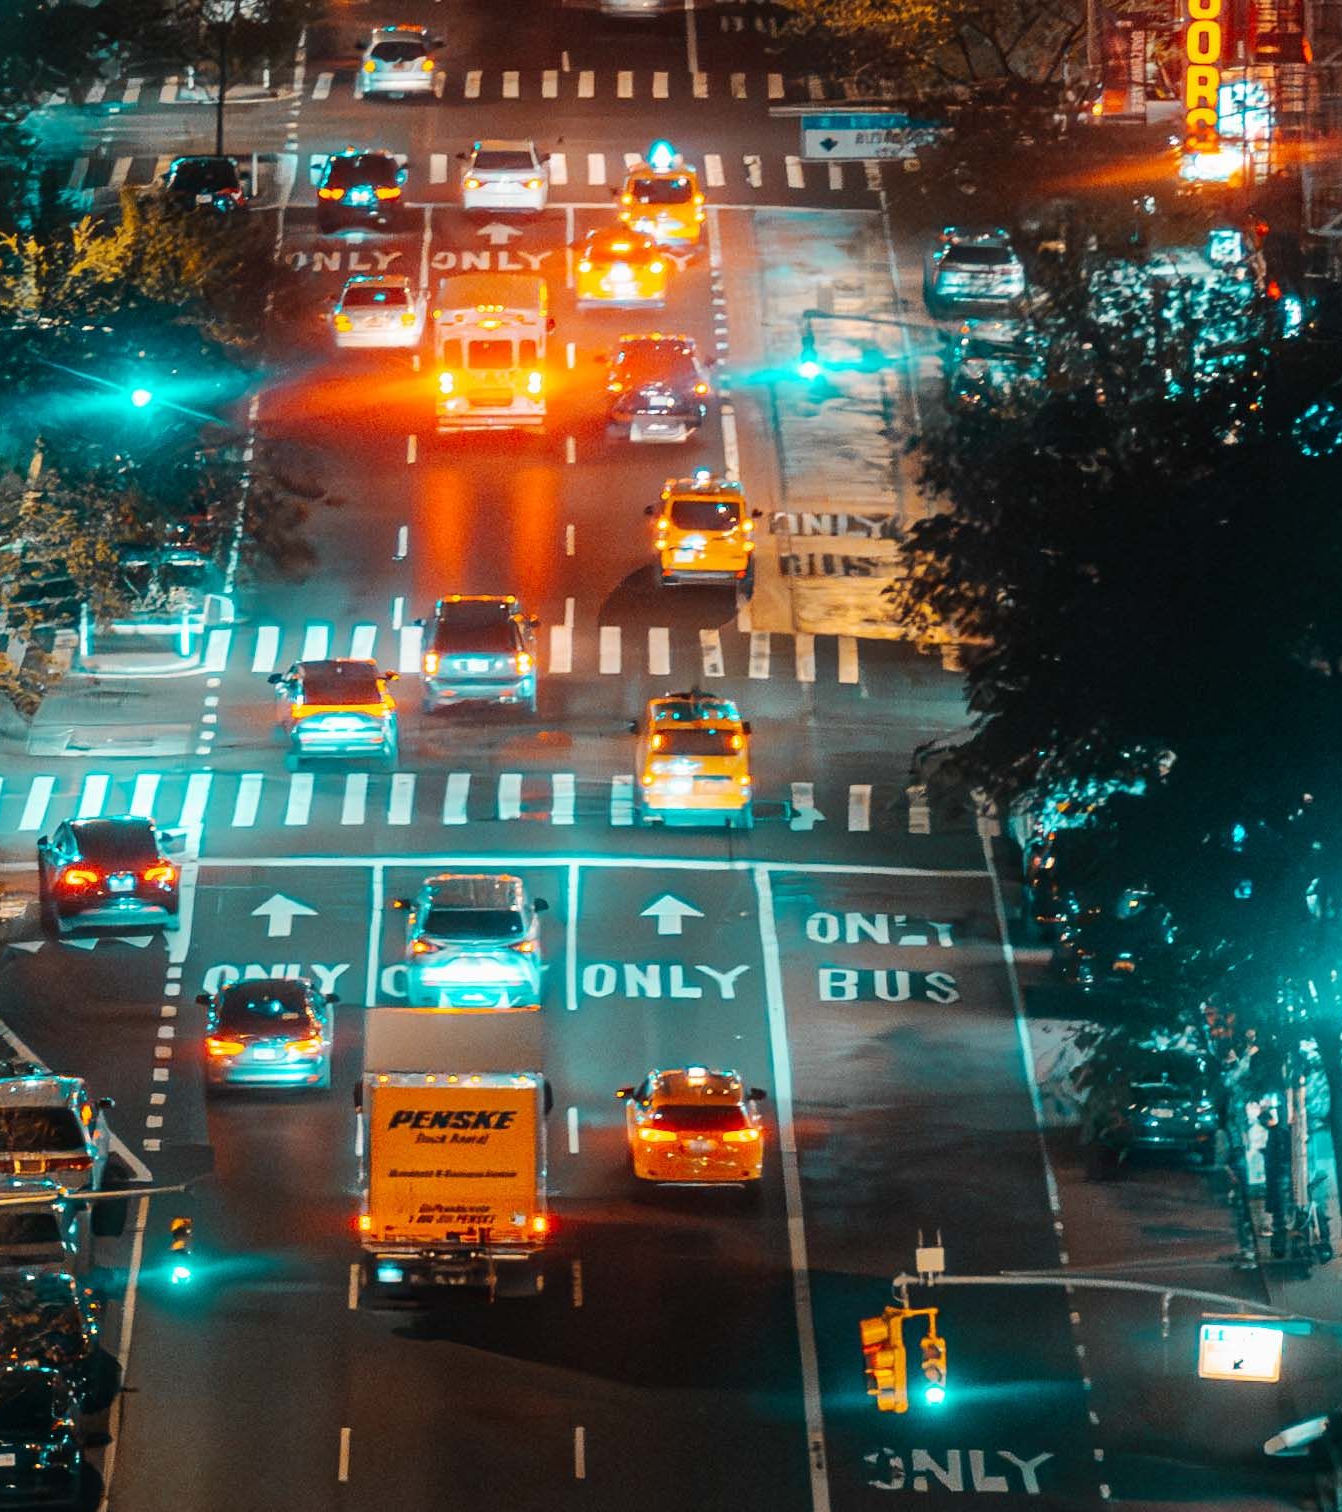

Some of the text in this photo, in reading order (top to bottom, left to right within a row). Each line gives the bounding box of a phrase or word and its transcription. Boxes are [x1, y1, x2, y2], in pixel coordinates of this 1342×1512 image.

[430, 249, 554, 272] ONLY
[582, 963, 751, 999] ONLY
[818, 968, 961, 1004] BUS
[388, 1110, 517, 1129] PENSKE
